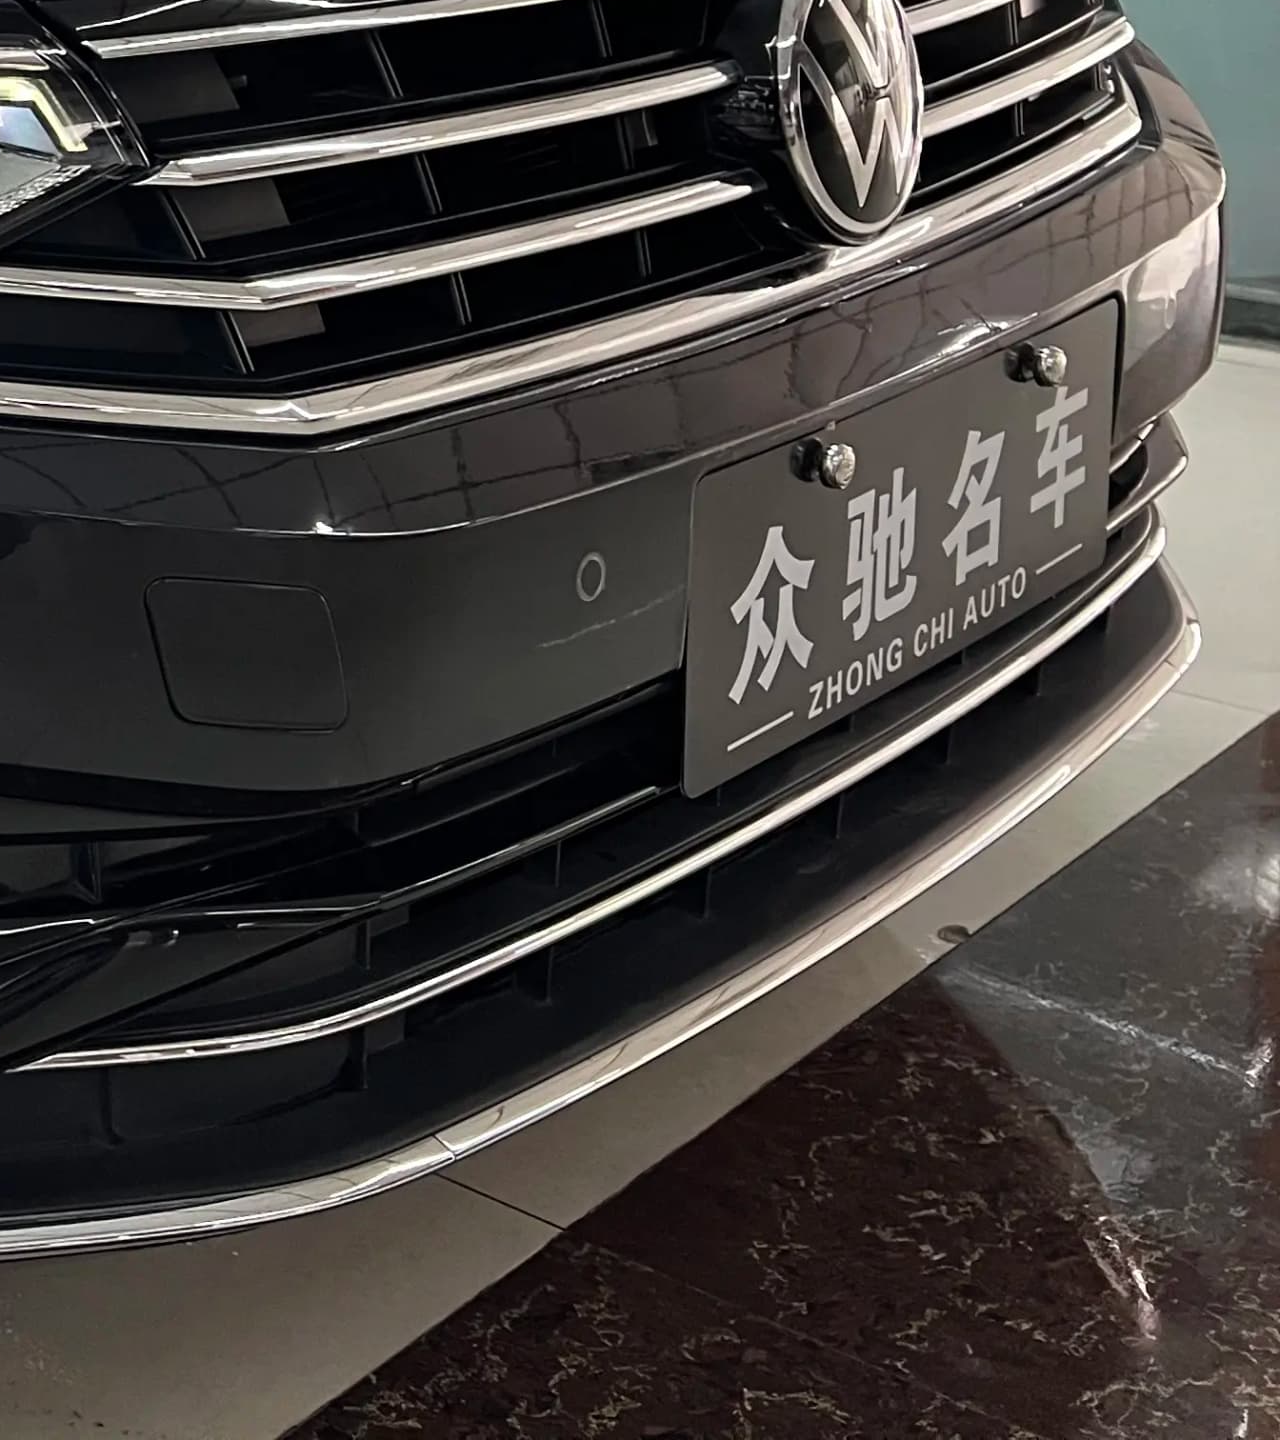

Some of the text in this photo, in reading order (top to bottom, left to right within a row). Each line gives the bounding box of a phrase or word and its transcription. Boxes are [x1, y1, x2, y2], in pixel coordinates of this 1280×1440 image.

[727, 385, 1089, 705] 众驰名车
[807, 566, 1027, 720] ZHONG CHI AUTO
